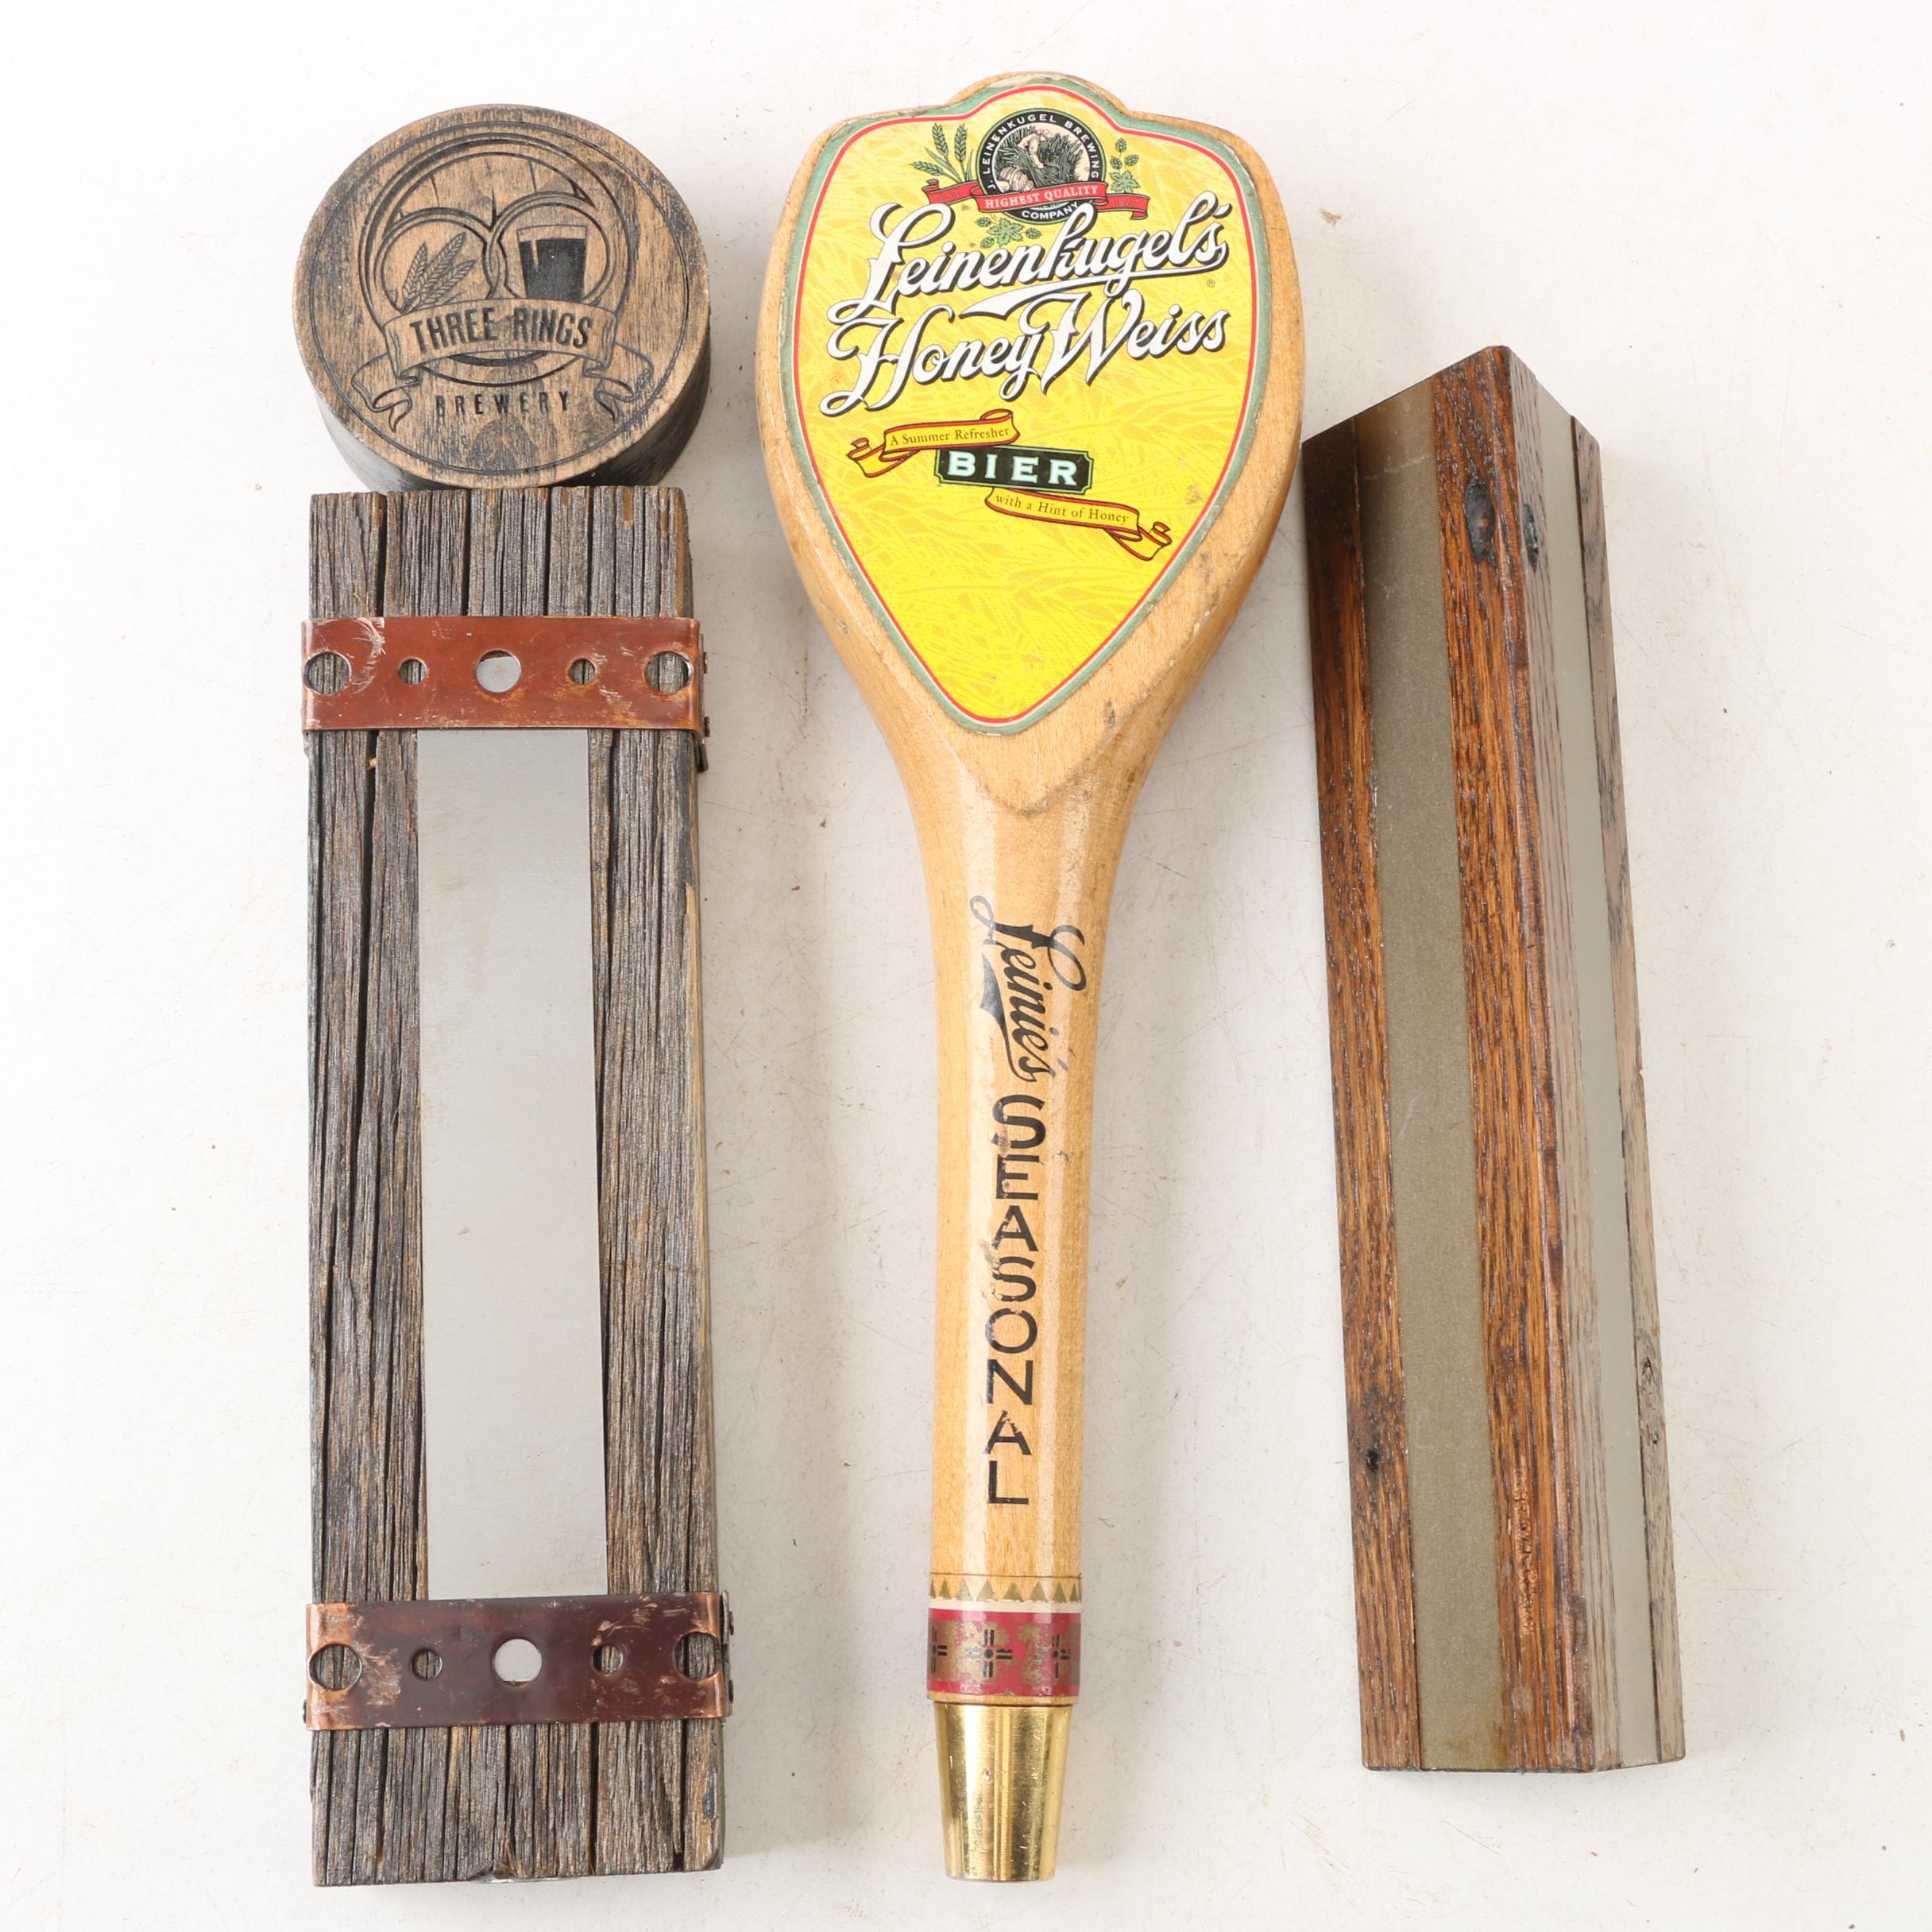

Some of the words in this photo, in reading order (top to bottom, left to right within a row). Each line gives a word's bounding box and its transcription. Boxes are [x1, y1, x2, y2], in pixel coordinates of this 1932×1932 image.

[983, 114, 1057, 174] LEINENKUGEL
[1065, 119, 1099, 179] BREWING
[984, 193, 1040, 209] HIGHEST
[1044, 185, 1099, 199] QUALITY
[1022, 202, 1078, 219] COMPANY
[827, 191, 1231, 324] Leinenkugel's
[409, 307, 499, 354] THREE
[511, 307, 593, 349] RINGS
[819, 305, 1042, 417] Honey
[1018, 288, 1231, 395] Weiss
[435, 389, 570, 415] BREWERY
[890, 435, 899, 446] A
[902, 435, 950, 445] Summer
[954, 427, 1010, 440] Refresher
[948, 450, 1078, 487] BIER
[995, 493, 1022, 508] with
[1026, 501, 1034, 511] a
[1037, 500, 1067, 516] Hint
[1071, 507, 1084, 519] of
[1089, 508, 1129, 527] Honey
[969, 895, 1088, 1083] Leinie's
[982, 1094, 1046, 1505] SEASONAL
